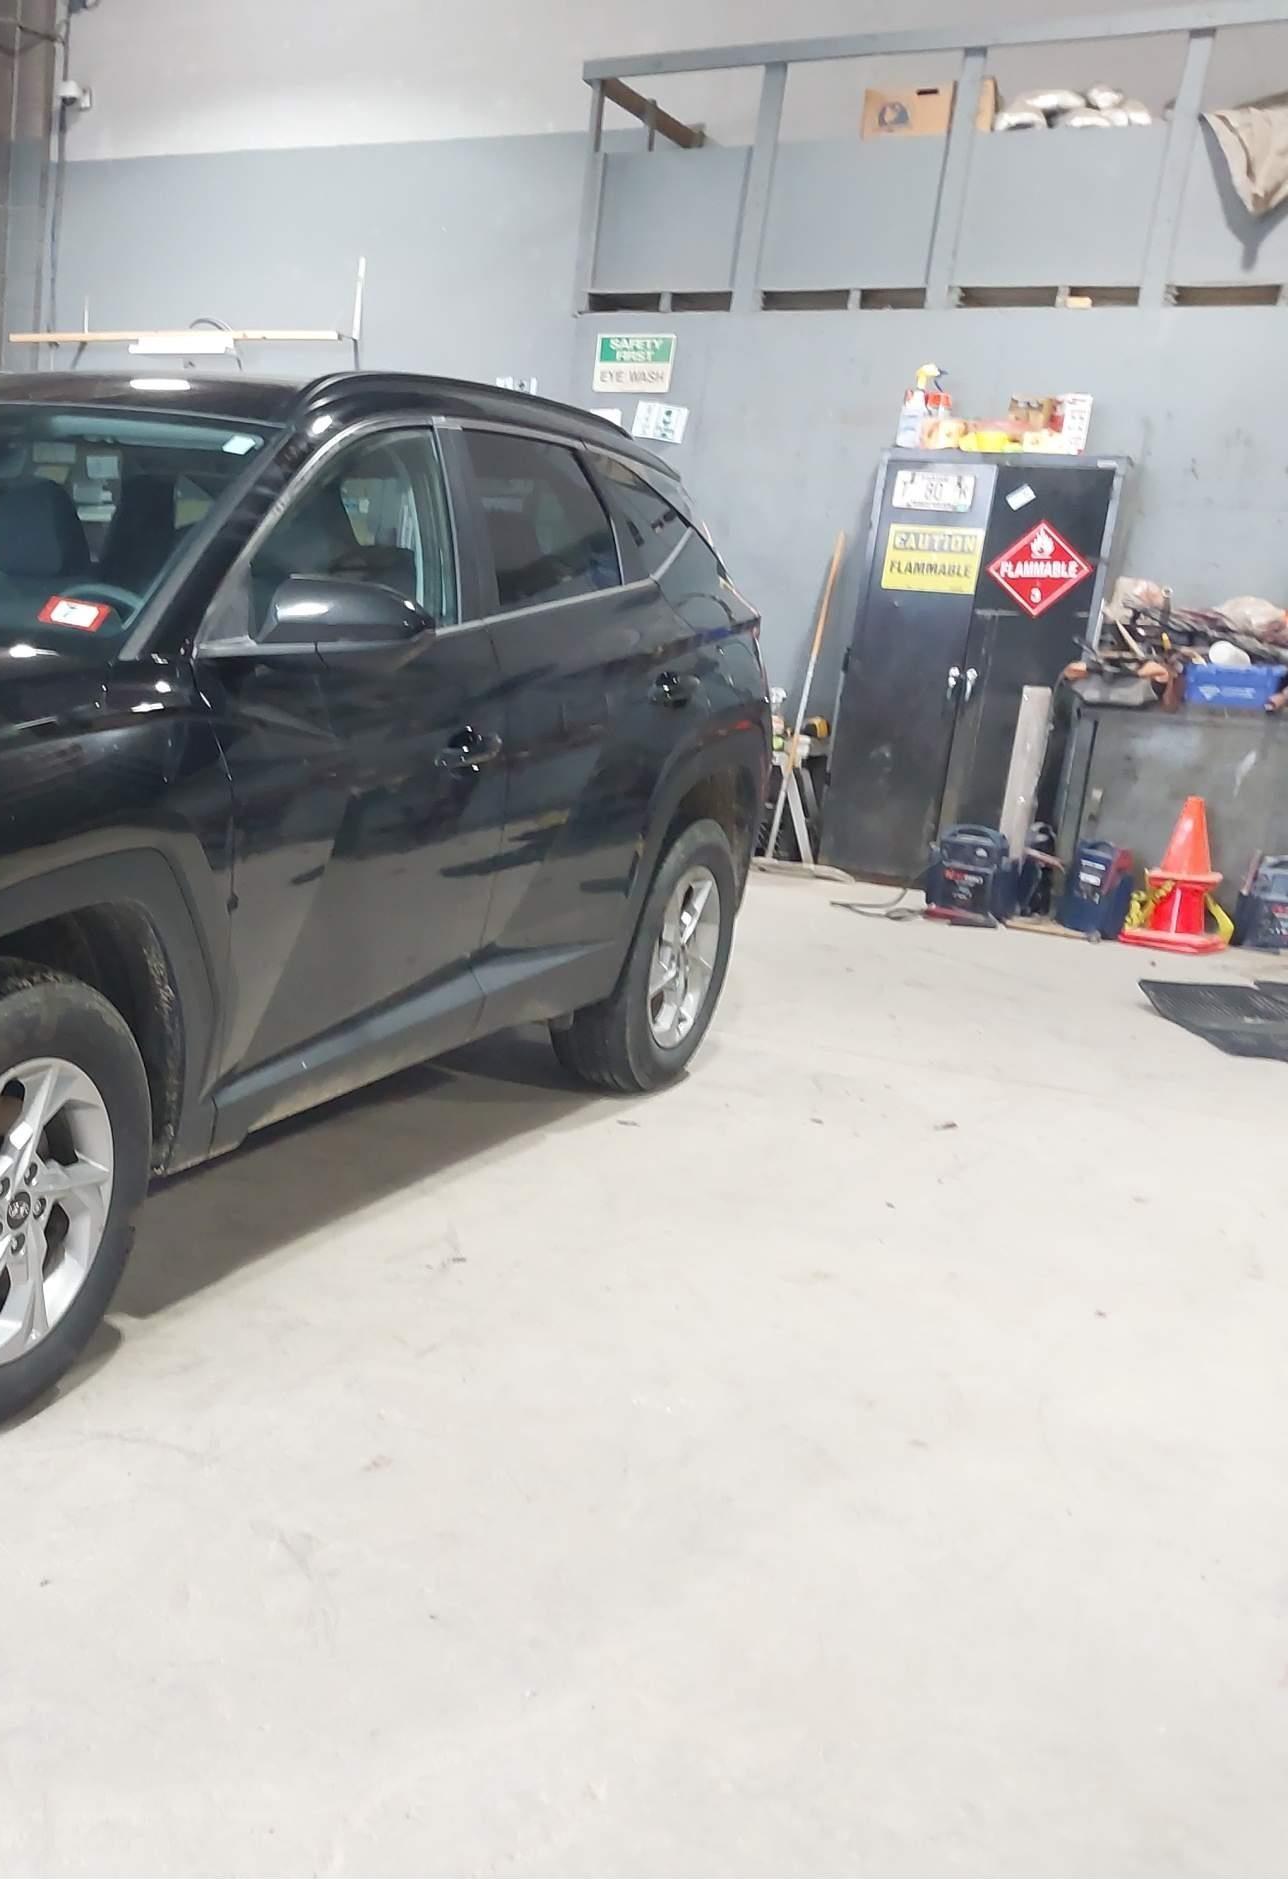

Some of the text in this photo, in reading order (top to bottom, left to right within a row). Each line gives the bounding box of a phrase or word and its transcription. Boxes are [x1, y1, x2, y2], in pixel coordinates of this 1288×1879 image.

[609, 338, 664, 350] SAFETY
[615, 350, 655, 361] FIRST
[599, 370, 665, 383] EYE WASH
[893, 530, 977, 554] CAUTION
[888, 559, 972, 578] FLAMMABLE
[999, 560, 1080, 579] FLAMMABLE
